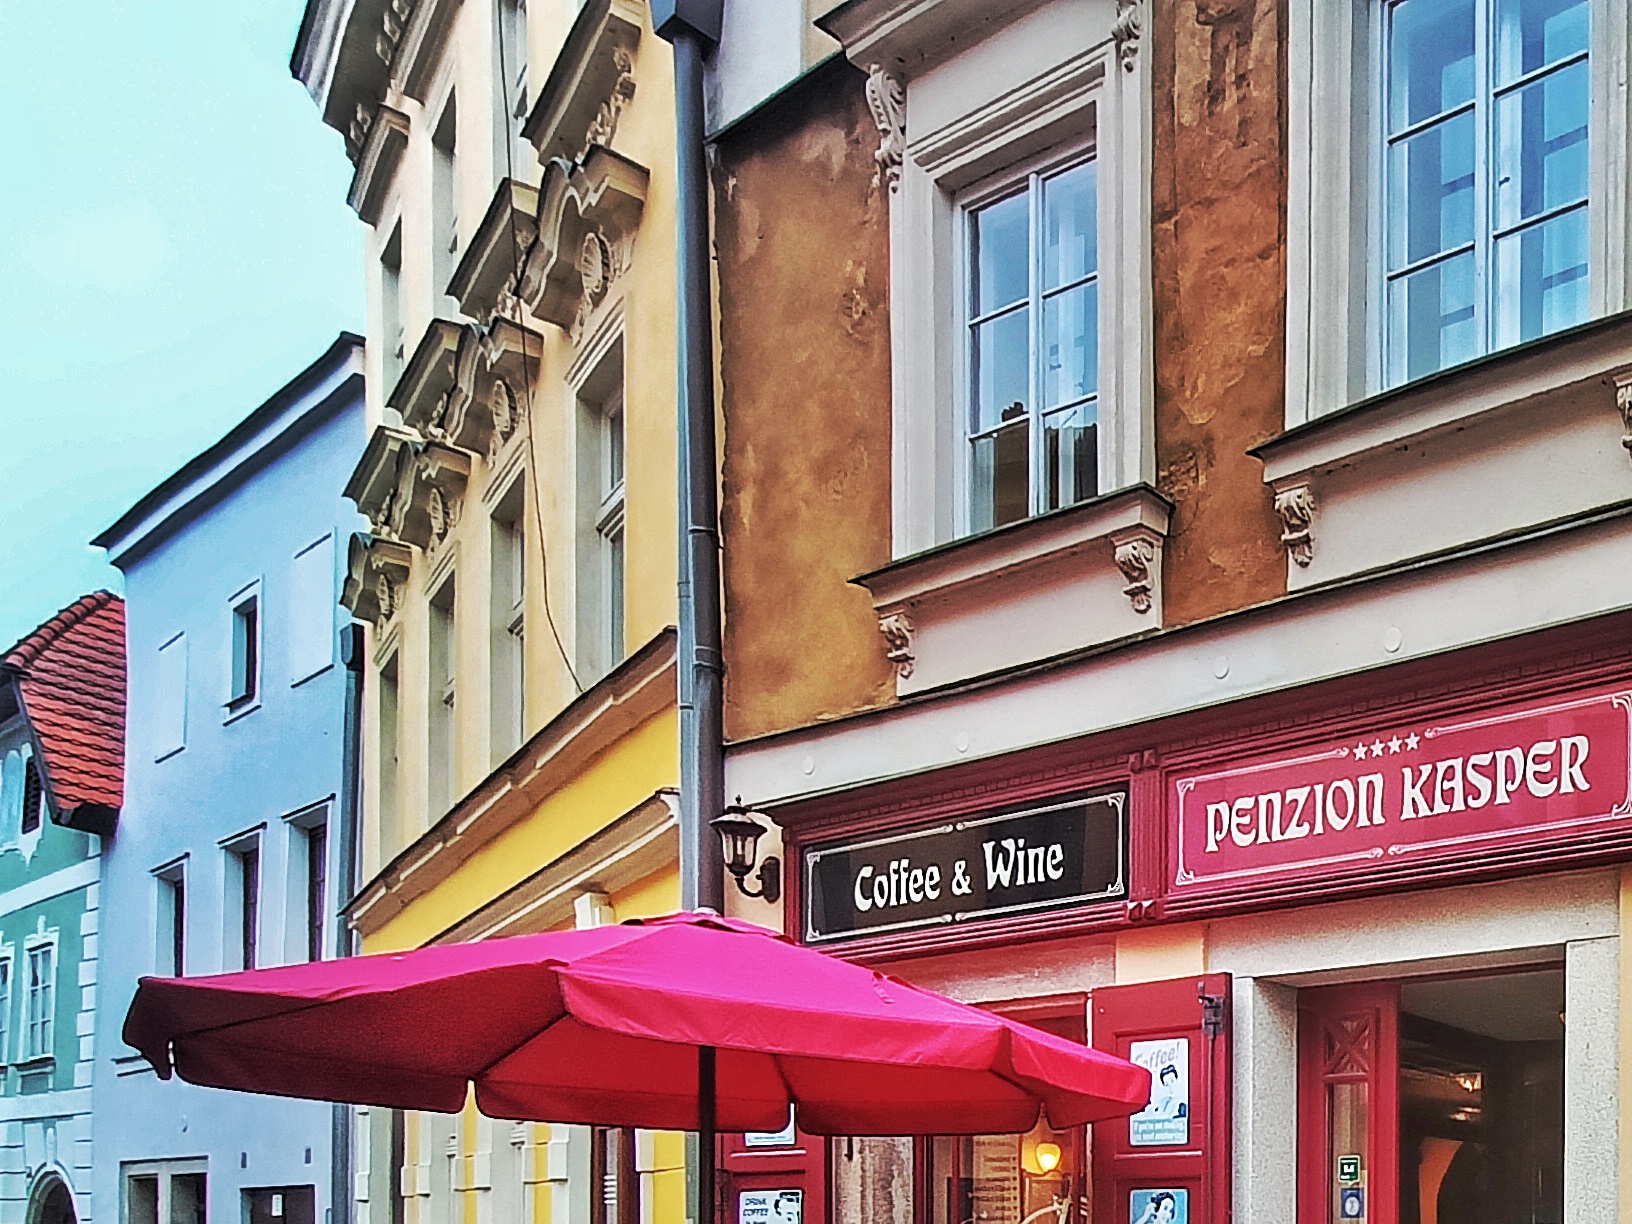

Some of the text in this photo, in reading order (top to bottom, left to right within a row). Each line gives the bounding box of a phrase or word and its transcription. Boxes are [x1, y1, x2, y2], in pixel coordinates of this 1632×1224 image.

[1205, 735, 1591, 853] PENZION KASPER
[854, 838, 1064, 912] Coffee & Wine
